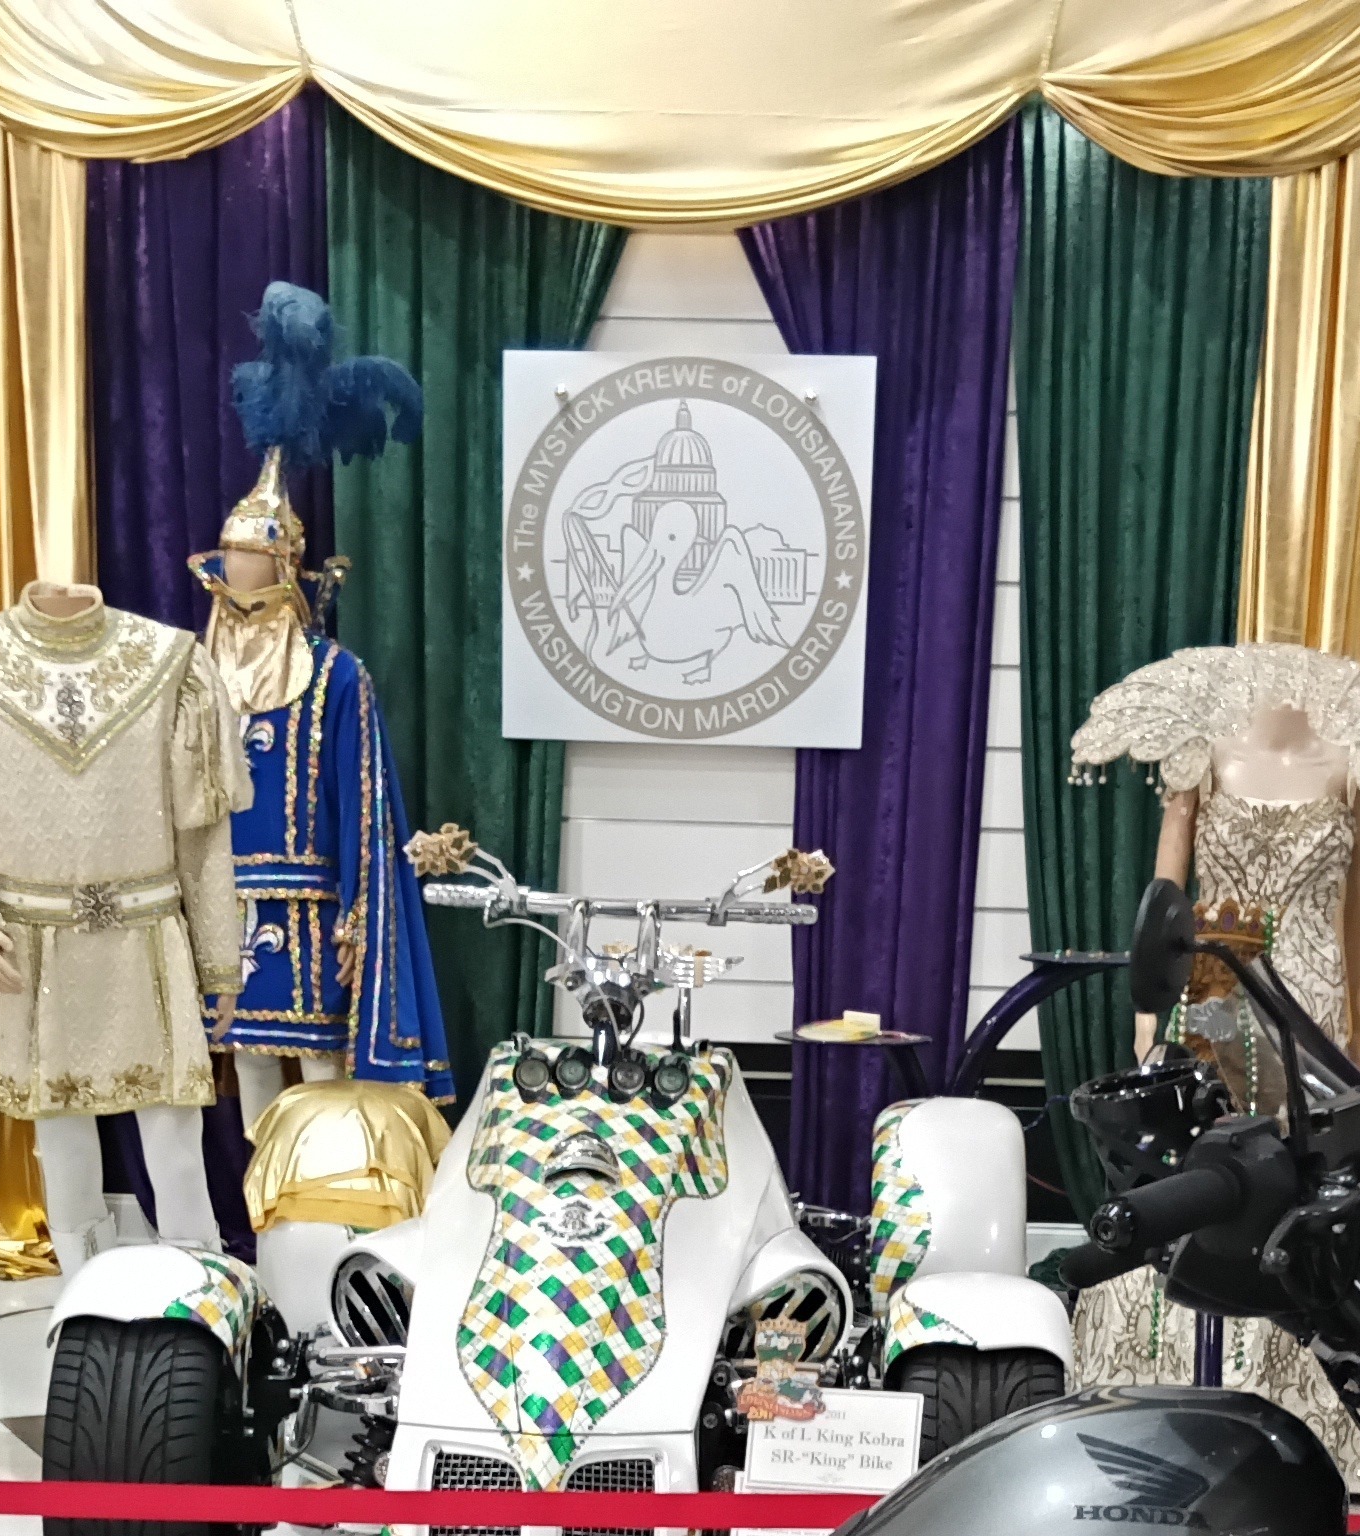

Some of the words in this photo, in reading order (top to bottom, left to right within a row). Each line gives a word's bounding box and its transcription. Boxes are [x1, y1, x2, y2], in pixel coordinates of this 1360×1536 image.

[616, 364, 716, 399] KREWE
[722, 375, 748, 397] of
[524, 386, 615, 496] MYSTICK
[751, 384, 859, 562] LOUISIANIANS
[514, 503, 539, 554] The
[520, 591, 685, 732] WASHINGTON
[694, 675, 791, 732] MARDI
[788, 600, 849, 681] GRAS
[763, 1425, 777, 1440] K
[781, 1426, 796, 1440] of
[816, 1429, 854, 1446] King
[859, 1431, 905, 1448] Kobra
[860, 1455, 893, 1470] Bike
[1073, 1505, 1212, 1530] HONDA
